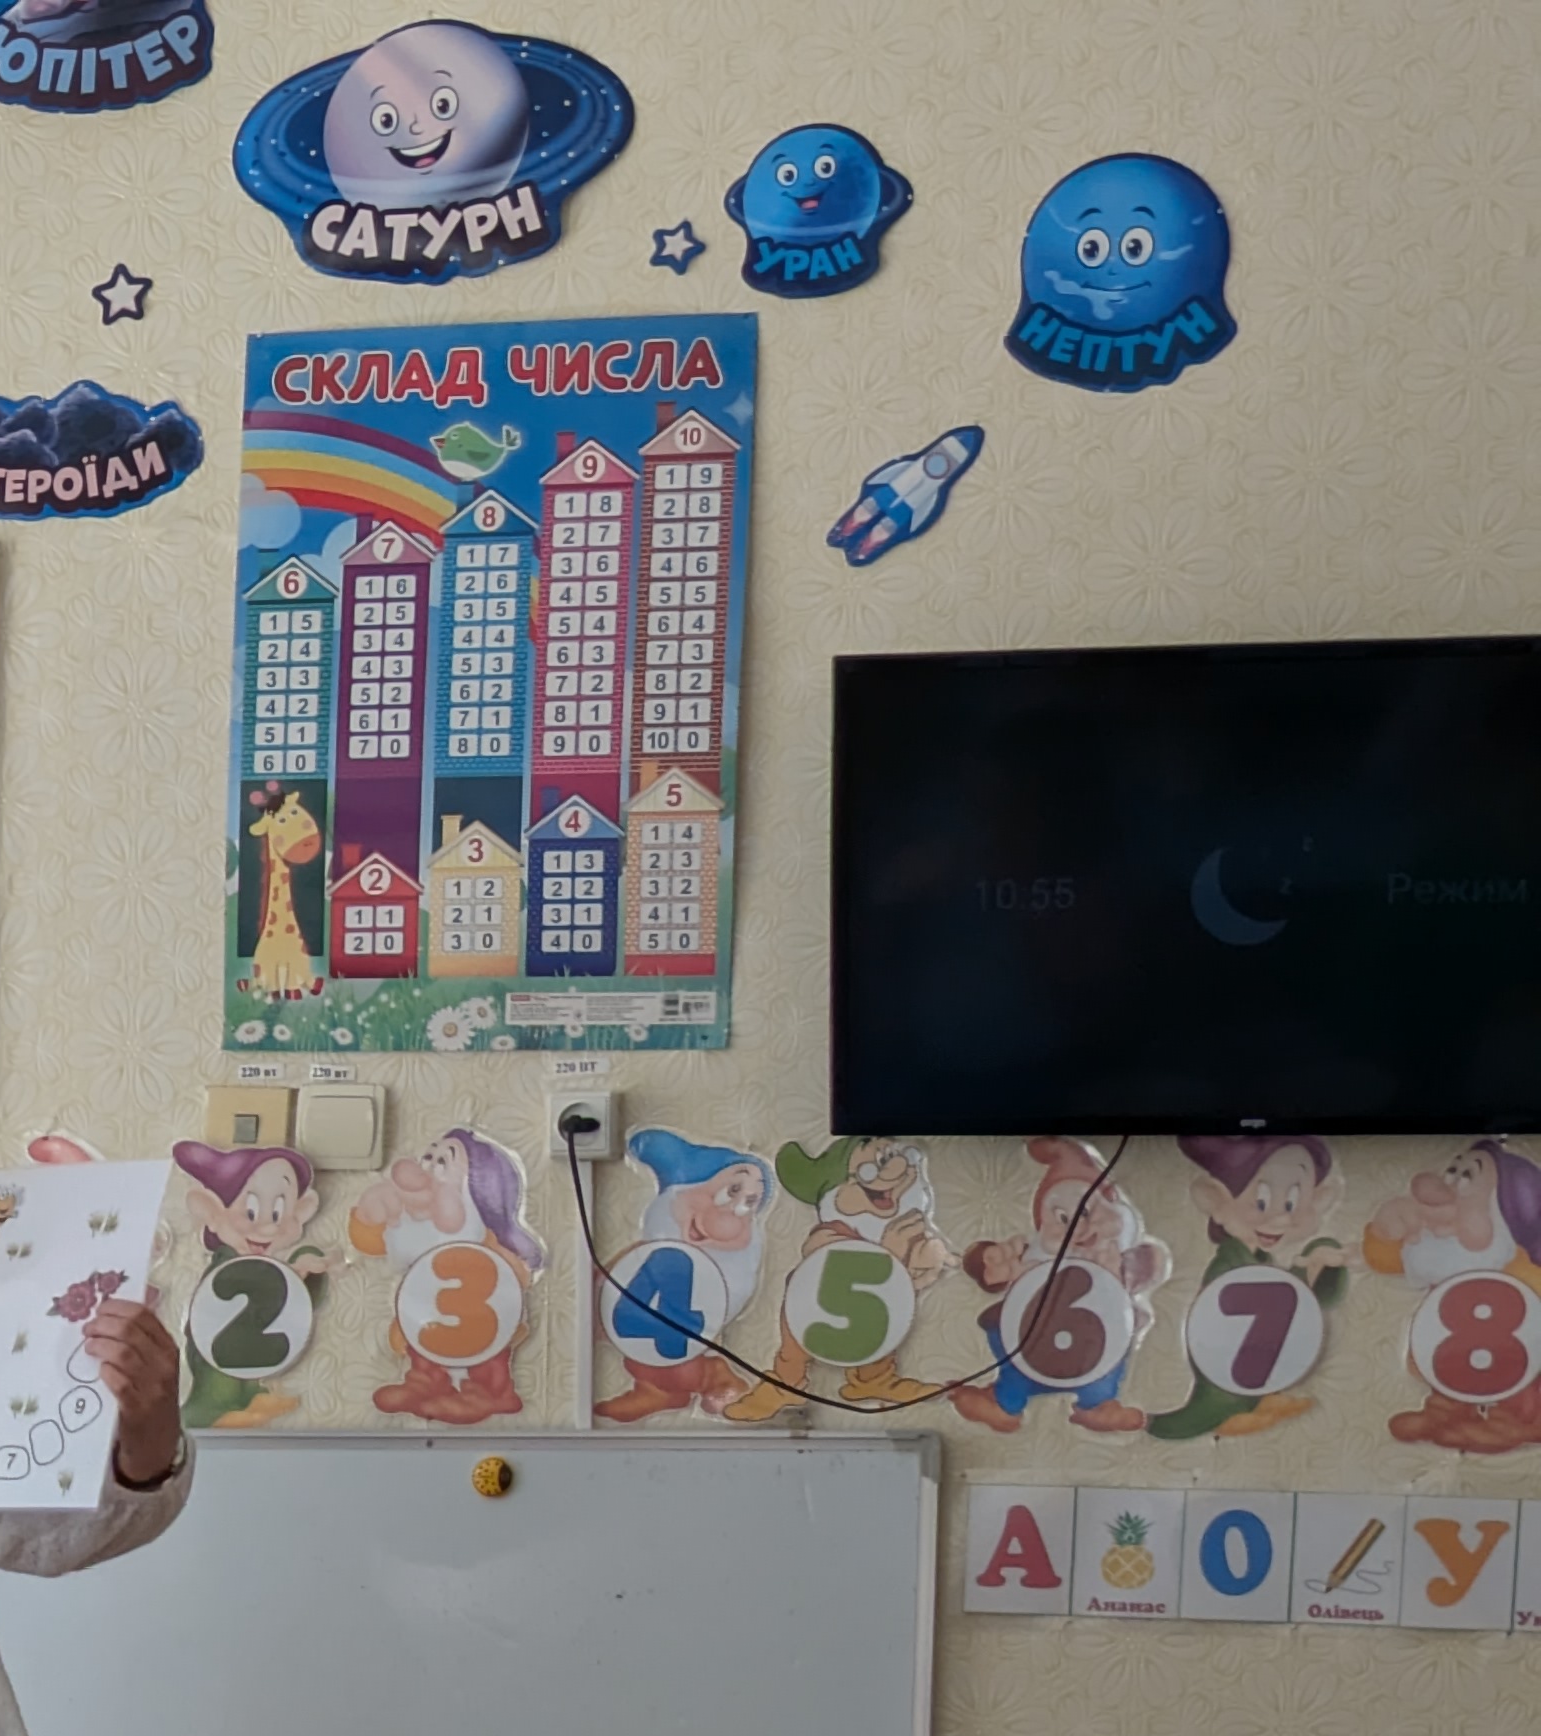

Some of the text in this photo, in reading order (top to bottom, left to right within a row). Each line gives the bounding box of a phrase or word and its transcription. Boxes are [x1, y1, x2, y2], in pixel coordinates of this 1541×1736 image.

[310, 184, 546, 263] САТУРН
[752, 236, 865, 281] УРАН
[1017, 299, 1221, 374] НЕПТУН
[273, 336, 723, 408] СКЛАД ЧИСЛА
[679, 427, 702, 446] 10
[582, 454, 598, 479] 9
[666, 466, 713, 485] 1 9
[565, 495, 612, 514] 1 8
[663, 495, 711, 516] 2 8
[481, 506, 496, 527] 8
[562, 524, 611, 545] 2 7
[661, 525, 710, 546] 3 7
[381, 537, 396, 559] 7
[560, 554, 609, 575] 3 6
[659, 555, 708, 574] 4 6
[283, 570, 300, 595] 6
[365, 578, 407, 595] 1 6
[559, 585, 608, 604] 4 5
[659, 585, 707, 605] 5 5
[269, 613, 313, 631] 1 5
[363, 605, 407, 623] 2 5
[657, 614, 705, 633] 6 4
[557, 615, 606, 635] 5 4
[267, 641, 311, 660] 2 4
[362, 632, 405, 650] 3 4
[556, 645, 605, 664] 6 3
[656, 643, 704, 662] 7 3
[360, 659, 404, 676] 4 3
[265, 669, 310, 688] 3 3
[555, 674, 604, 693] 7 2
[654, 672, 702, 691] 8 2
[360, 686, 402, 704] 5 2
[264, 697, 309, 715] 4 2
[554, 704, 600, 723] 8 1
[653, 702, 699, 721] 9 1
[358, 713, 399, 730] 6 1
[264, 726, 306, 744] 5 1
[553, 734, 601, 753] 9 0
[647, 731, 700, 750] 10 0
[358, 738, 401, 755] 7 0
[263, 754, 307, 772] 6 0
[665, 783, 682, 807] 5
[564, 809, 581, 832] 4
[650, 825, 694, 841] 1 4
[467, 837, 484, 863] 3
[553, 853, 595, 870] 1 3
[649, 851, 693, 869] 2 3
[367, 867, 383, 892] 2
[453, 880, 495, 897] 1 2
[551, 879, 595, 897] 2 2
[648, 878, 692, 897] 3 2
[975, 871, 1529, 911] 10:55 Режим
[355, 909, 394, 925] 1 1
[452, 906, 492, 924] 2 1
[550, 906, 592, 924] 3 1
[647, 906, 690, 922] 4 1
[353, 934, 395, 952] 2 0
[451, 932, 494, 950] 3 0
[550, 933, 593, 950] 4 0
[647, 932, 691, 950] 5 0
[418, 1248, 499, 1359] 3
[612, 1247, 705, 1360] 4
[803, 1249, 893, 1362] 5
[211, 1259, 290, 1369] 2
[1019, 1265, 1106, 1379] 6
[1218, 1281, 1298, 1389] 7
[1432, 1278, 1529, 1396] 8
[74, 1397, 86, 1414] 9
[6, 1453, 17, 1470] 7
[975, 1504, 1063, 1589] А
[1199, 1509, 1273, 1596] О
[1414, 1518, 1510, 1608] У
[1086, 1597, 1166, 1614] Ананас
[1307, 1604, 1385, 1621] Олівець
